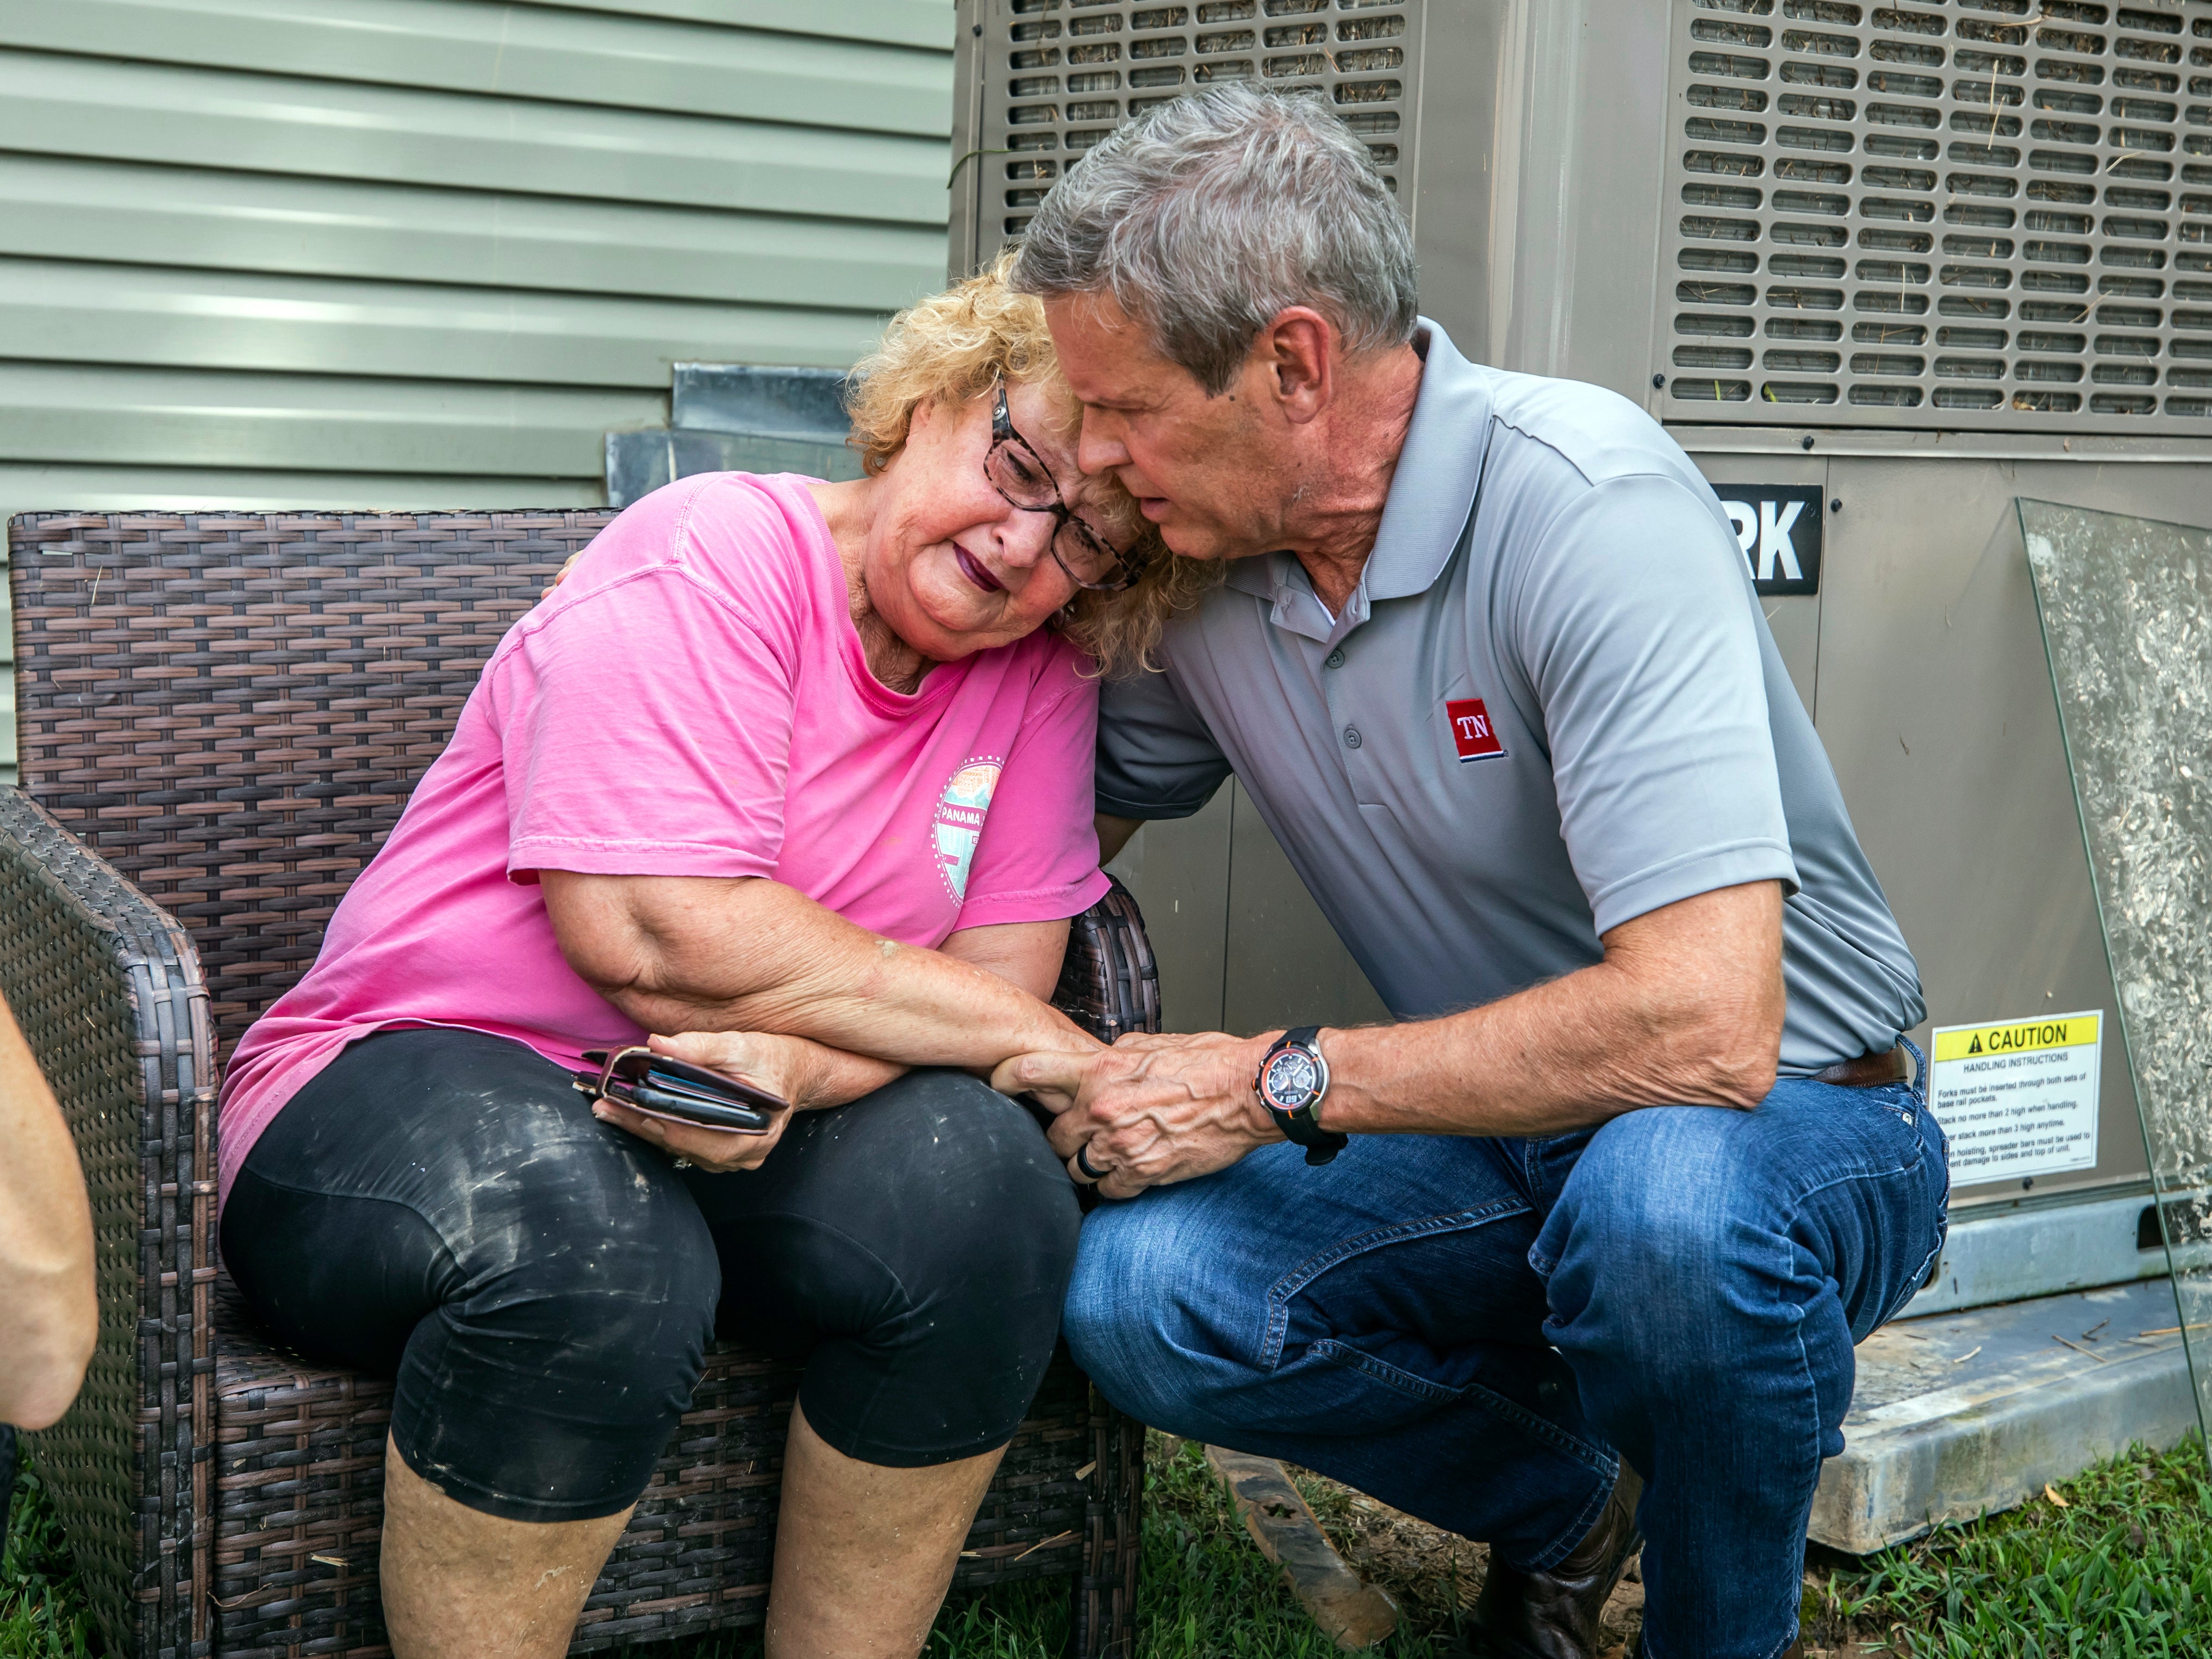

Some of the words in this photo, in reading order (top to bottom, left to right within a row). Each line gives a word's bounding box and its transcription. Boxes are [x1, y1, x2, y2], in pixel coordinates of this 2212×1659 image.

[1457, 715, 1489, 740] TN
[942, 807, 980, 826] PANAMA
[1989, 1023, 2067, 1050] CAUTION
[1964, 1059, 2006, 1072] HANDLING
[2009, 1052, 2068, 1068] INSTRUCTIONS
[1938, 1089, 1958, 1099] Forks
[1959, 1086, 1976, 1095] must
[1989, 1082, 2017, 1091] inserted
[2018, 1078, 2045, 1087] through
[2047, 1076, 2061, 1084] both
[2079, 1071, 2086, 1080] of
[1937, 1100, 1954, 1108] base
[1956, 1097, 1966, 1106] rail
[1968, 1095, 1997, 1107] pockets.
[1937, 1117, 1956, 1125] Stack
[1968, 1112, 1986, 1121] more
[1988, 1109, 2003, 1120] than
[2005, 1108, 2009, 1116] 2
[2011, 1106, 2026, 1117] high
[2028, 1105, 2045, 1113] when
[2047, 1100, 2078, 1110] handling.
[1958, 1131, 1976, 1139] stack
[1978, 1128, 1996, 1137] more
[1998, 1126, 2012, 1134] than
[2020, 1122, 2035, 1132] high
[2037, 1119, 2065, 1130] anytime.
[1957, 1146, 1986, 1156] hoisting,
[1989, 1142, 2018, 1153] spreader
[2020, 1140, 2035, 1148] bars
[2037, 1136, 2054, 1145] must
[2066, 1132, 2082, 1141] used
[1963, 1157, 1990, 1167] damage
[1992, 1153, 1998, 1162] to
[2001, 1151, 2018, 1161] sides
[2020, 1149, 2033, 1157] and
[2035, 1148, 2046, 1156] top
[2047, 1144, 2054, 1153] of
[2056, 1144, 2070, 1152] unit.
